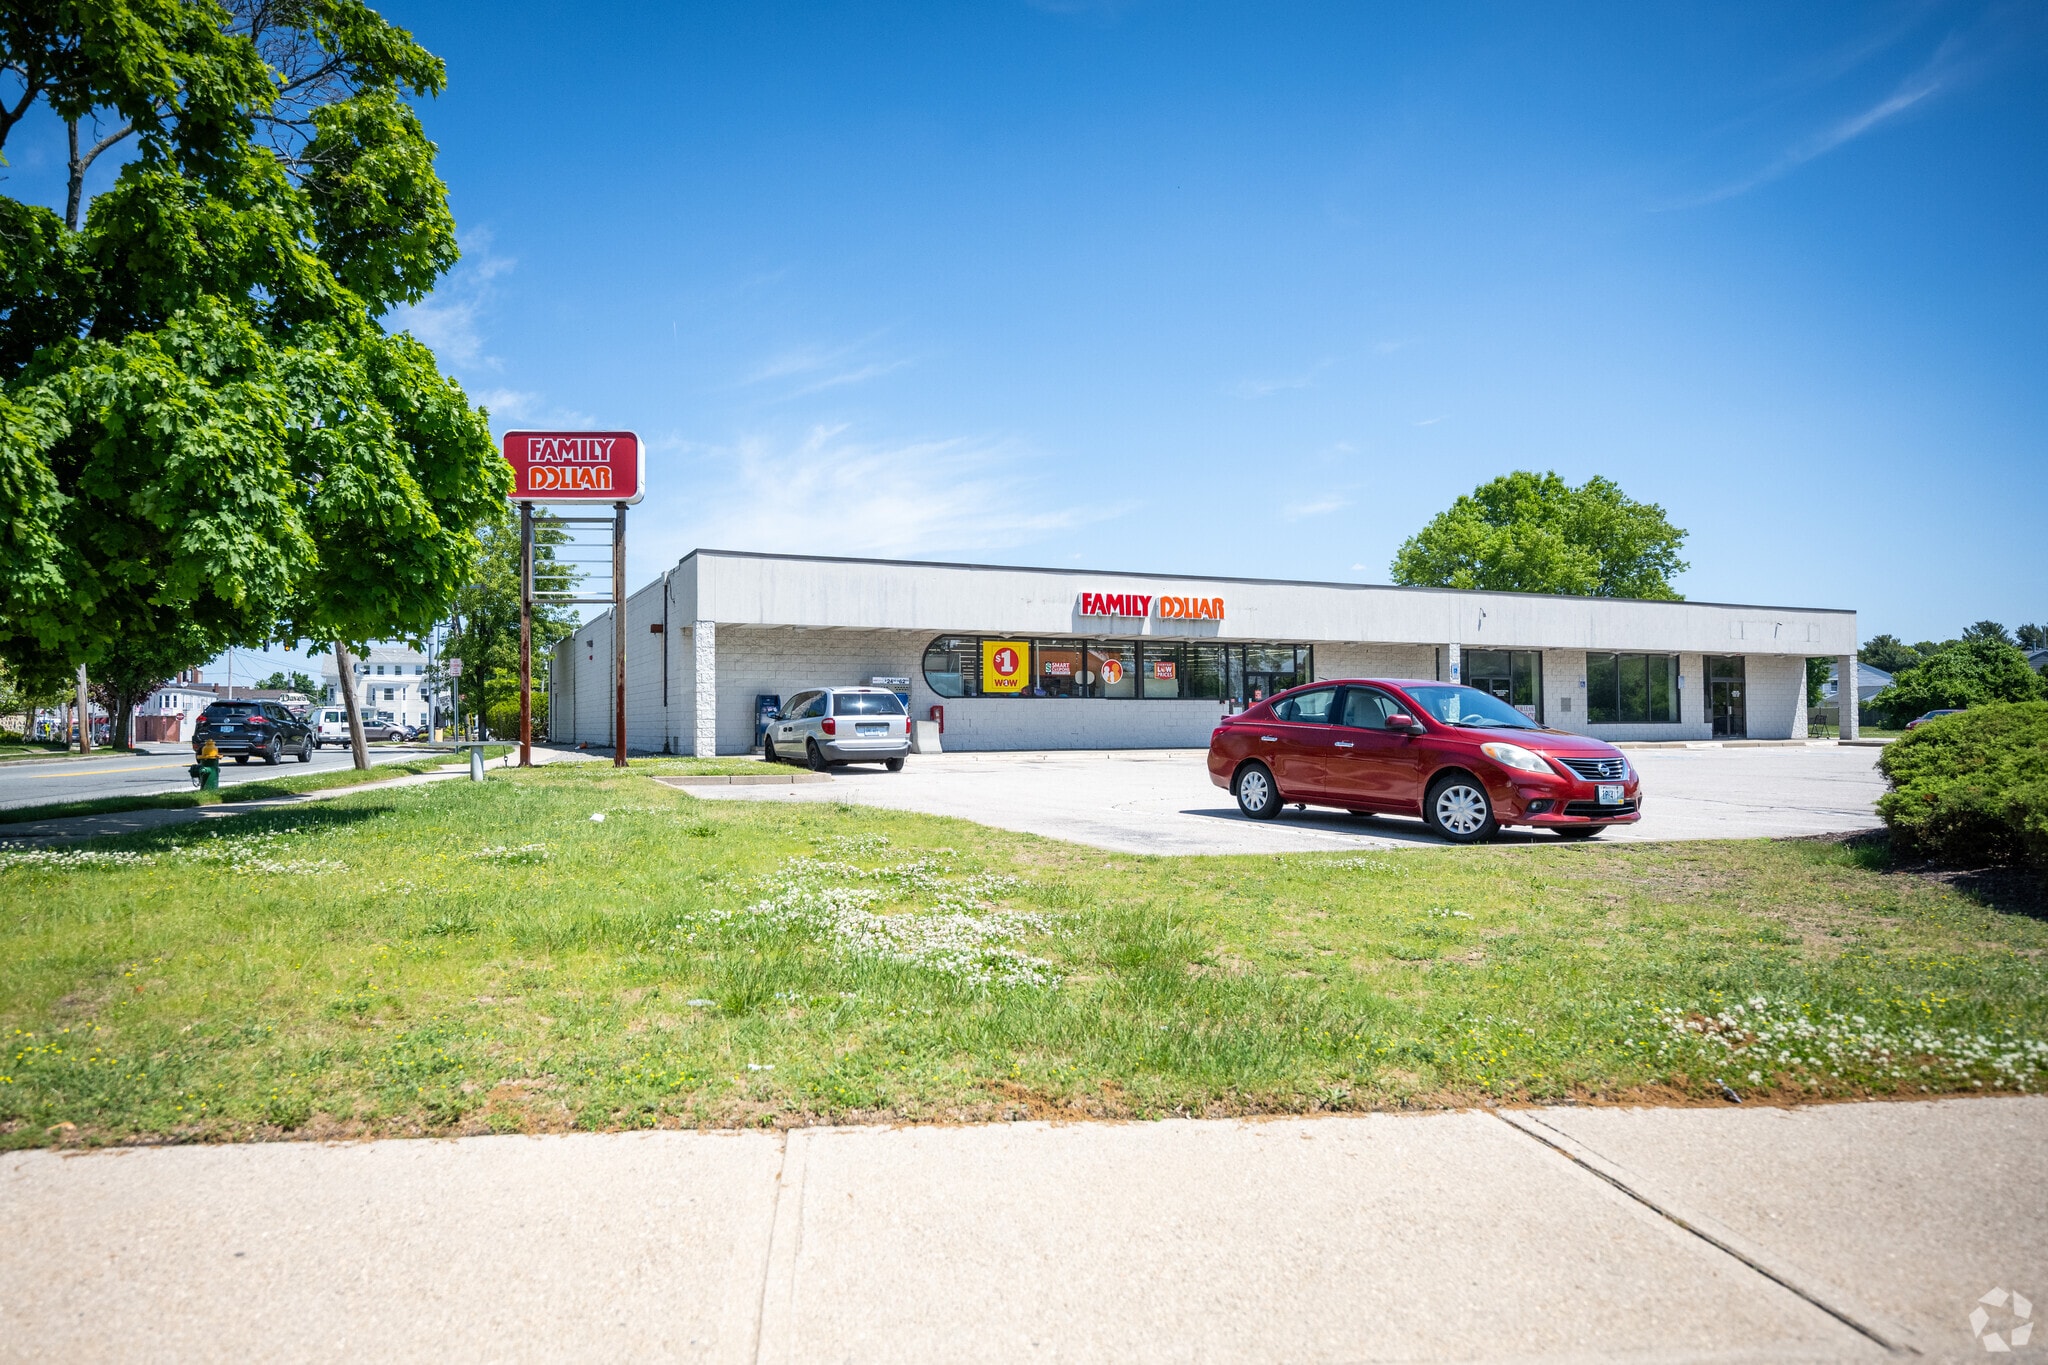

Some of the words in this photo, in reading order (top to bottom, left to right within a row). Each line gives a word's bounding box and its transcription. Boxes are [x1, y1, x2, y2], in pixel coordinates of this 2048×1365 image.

[528, 438, 616, 462] FAMILY
[528, 466, 612, 490] DOLLAR
[1081, 592, 1152, 617] FAMILY
[1159, 595, 1225, 620] DOLLAR
[995, 650, 1013, 672] $1
